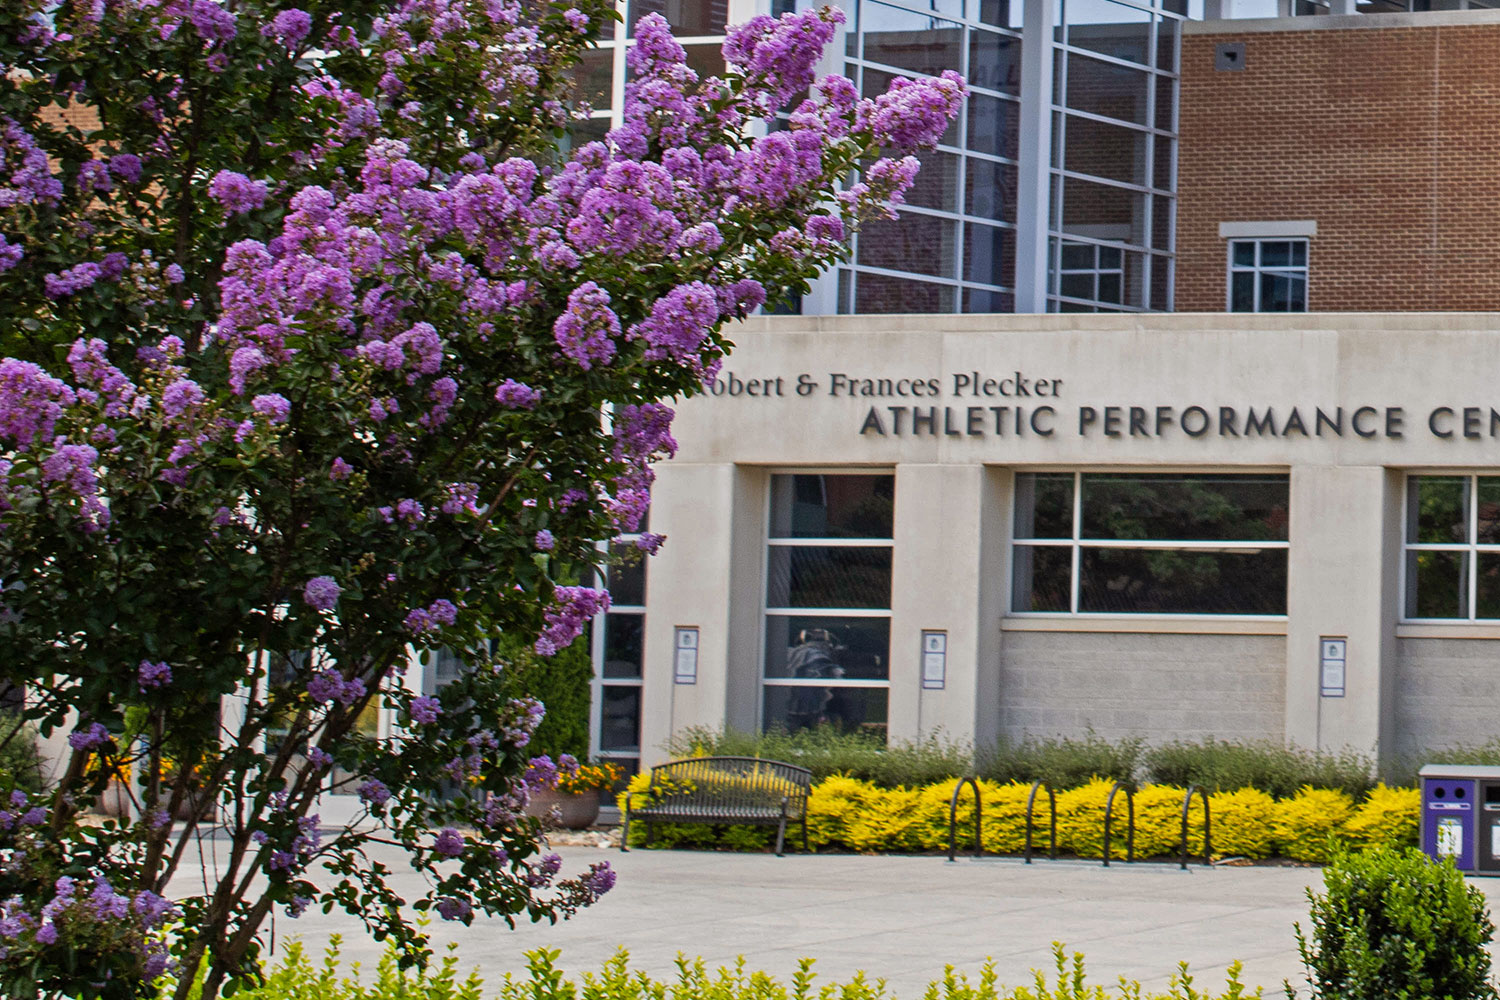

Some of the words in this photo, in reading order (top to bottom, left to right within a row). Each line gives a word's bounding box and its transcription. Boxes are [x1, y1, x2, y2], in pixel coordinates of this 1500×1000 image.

[796, 373, 818, 397] &
[829, 373, 940, 397] Frances
[953, 371, 1063, 397] Plecker
[859, 406, 1056, 439] ATHLETIC
[1079, 406, 1404, 440] PERFORMANCE
